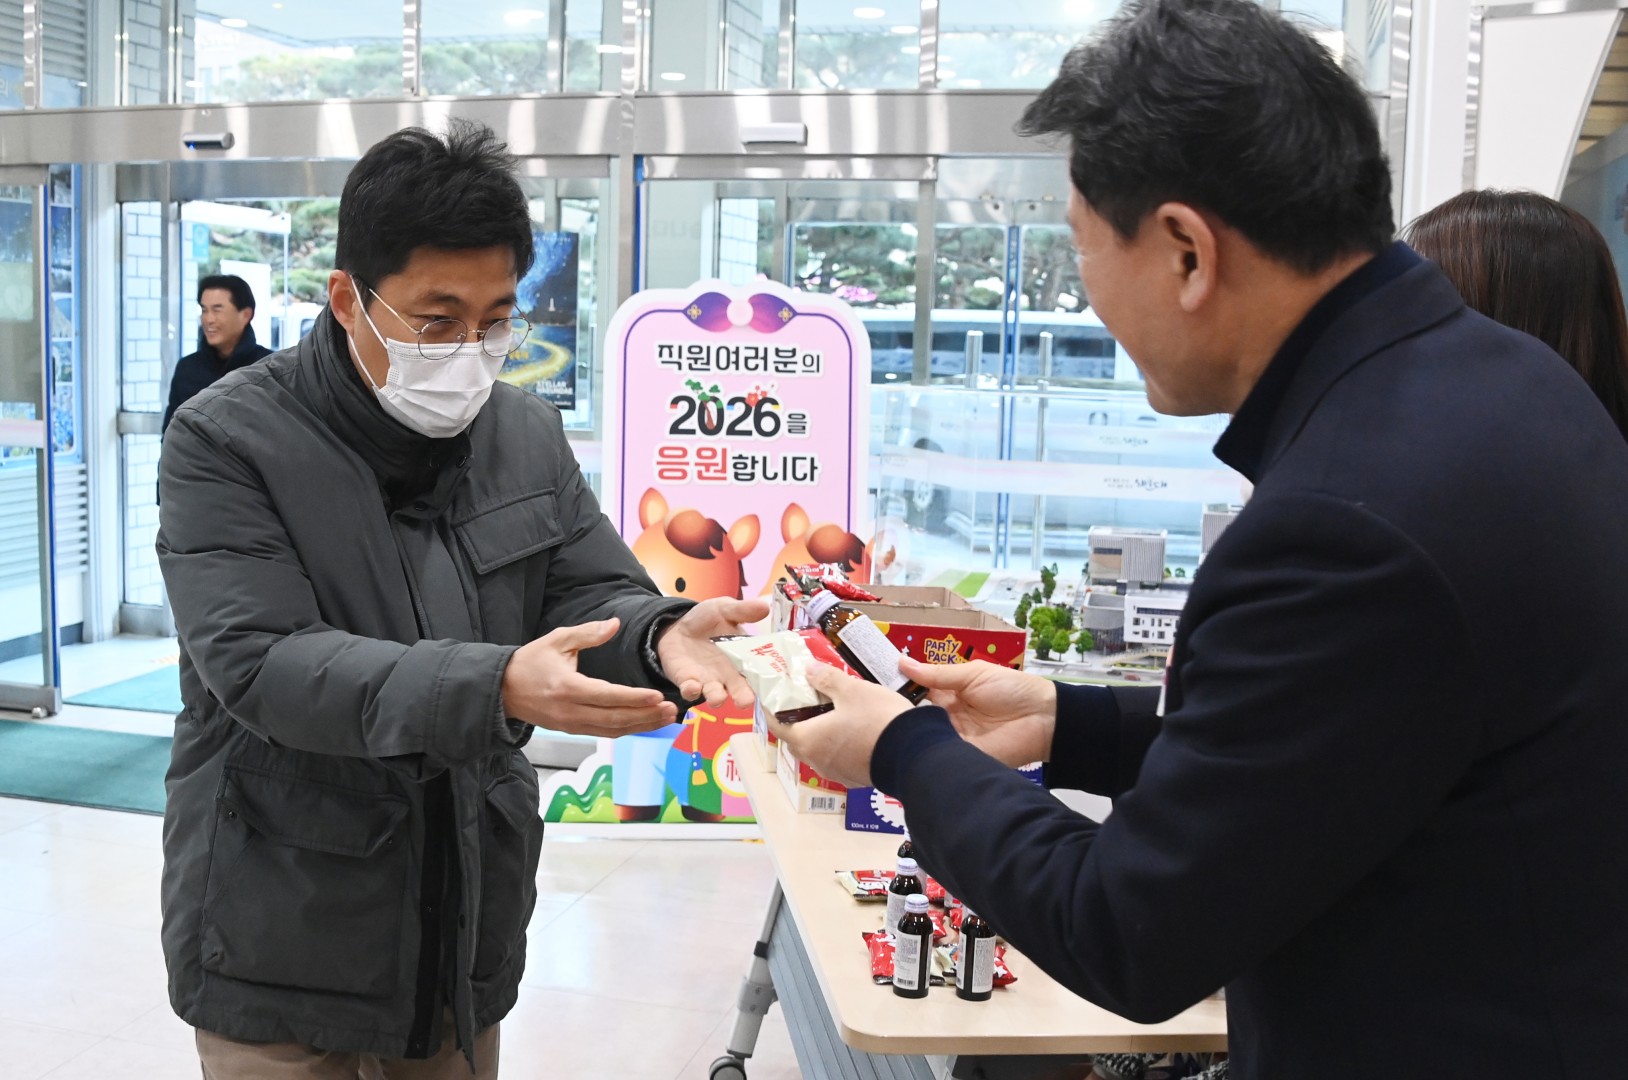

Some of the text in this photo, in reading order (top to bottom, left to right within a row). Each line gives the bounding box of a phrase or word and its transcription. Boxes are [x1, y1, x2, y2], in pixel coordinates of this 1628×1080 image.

[656, 446, 819, 483] 응원합니다
[925, 639, 960, 654] PARTY
[928, 650, 957, 664] PACK
